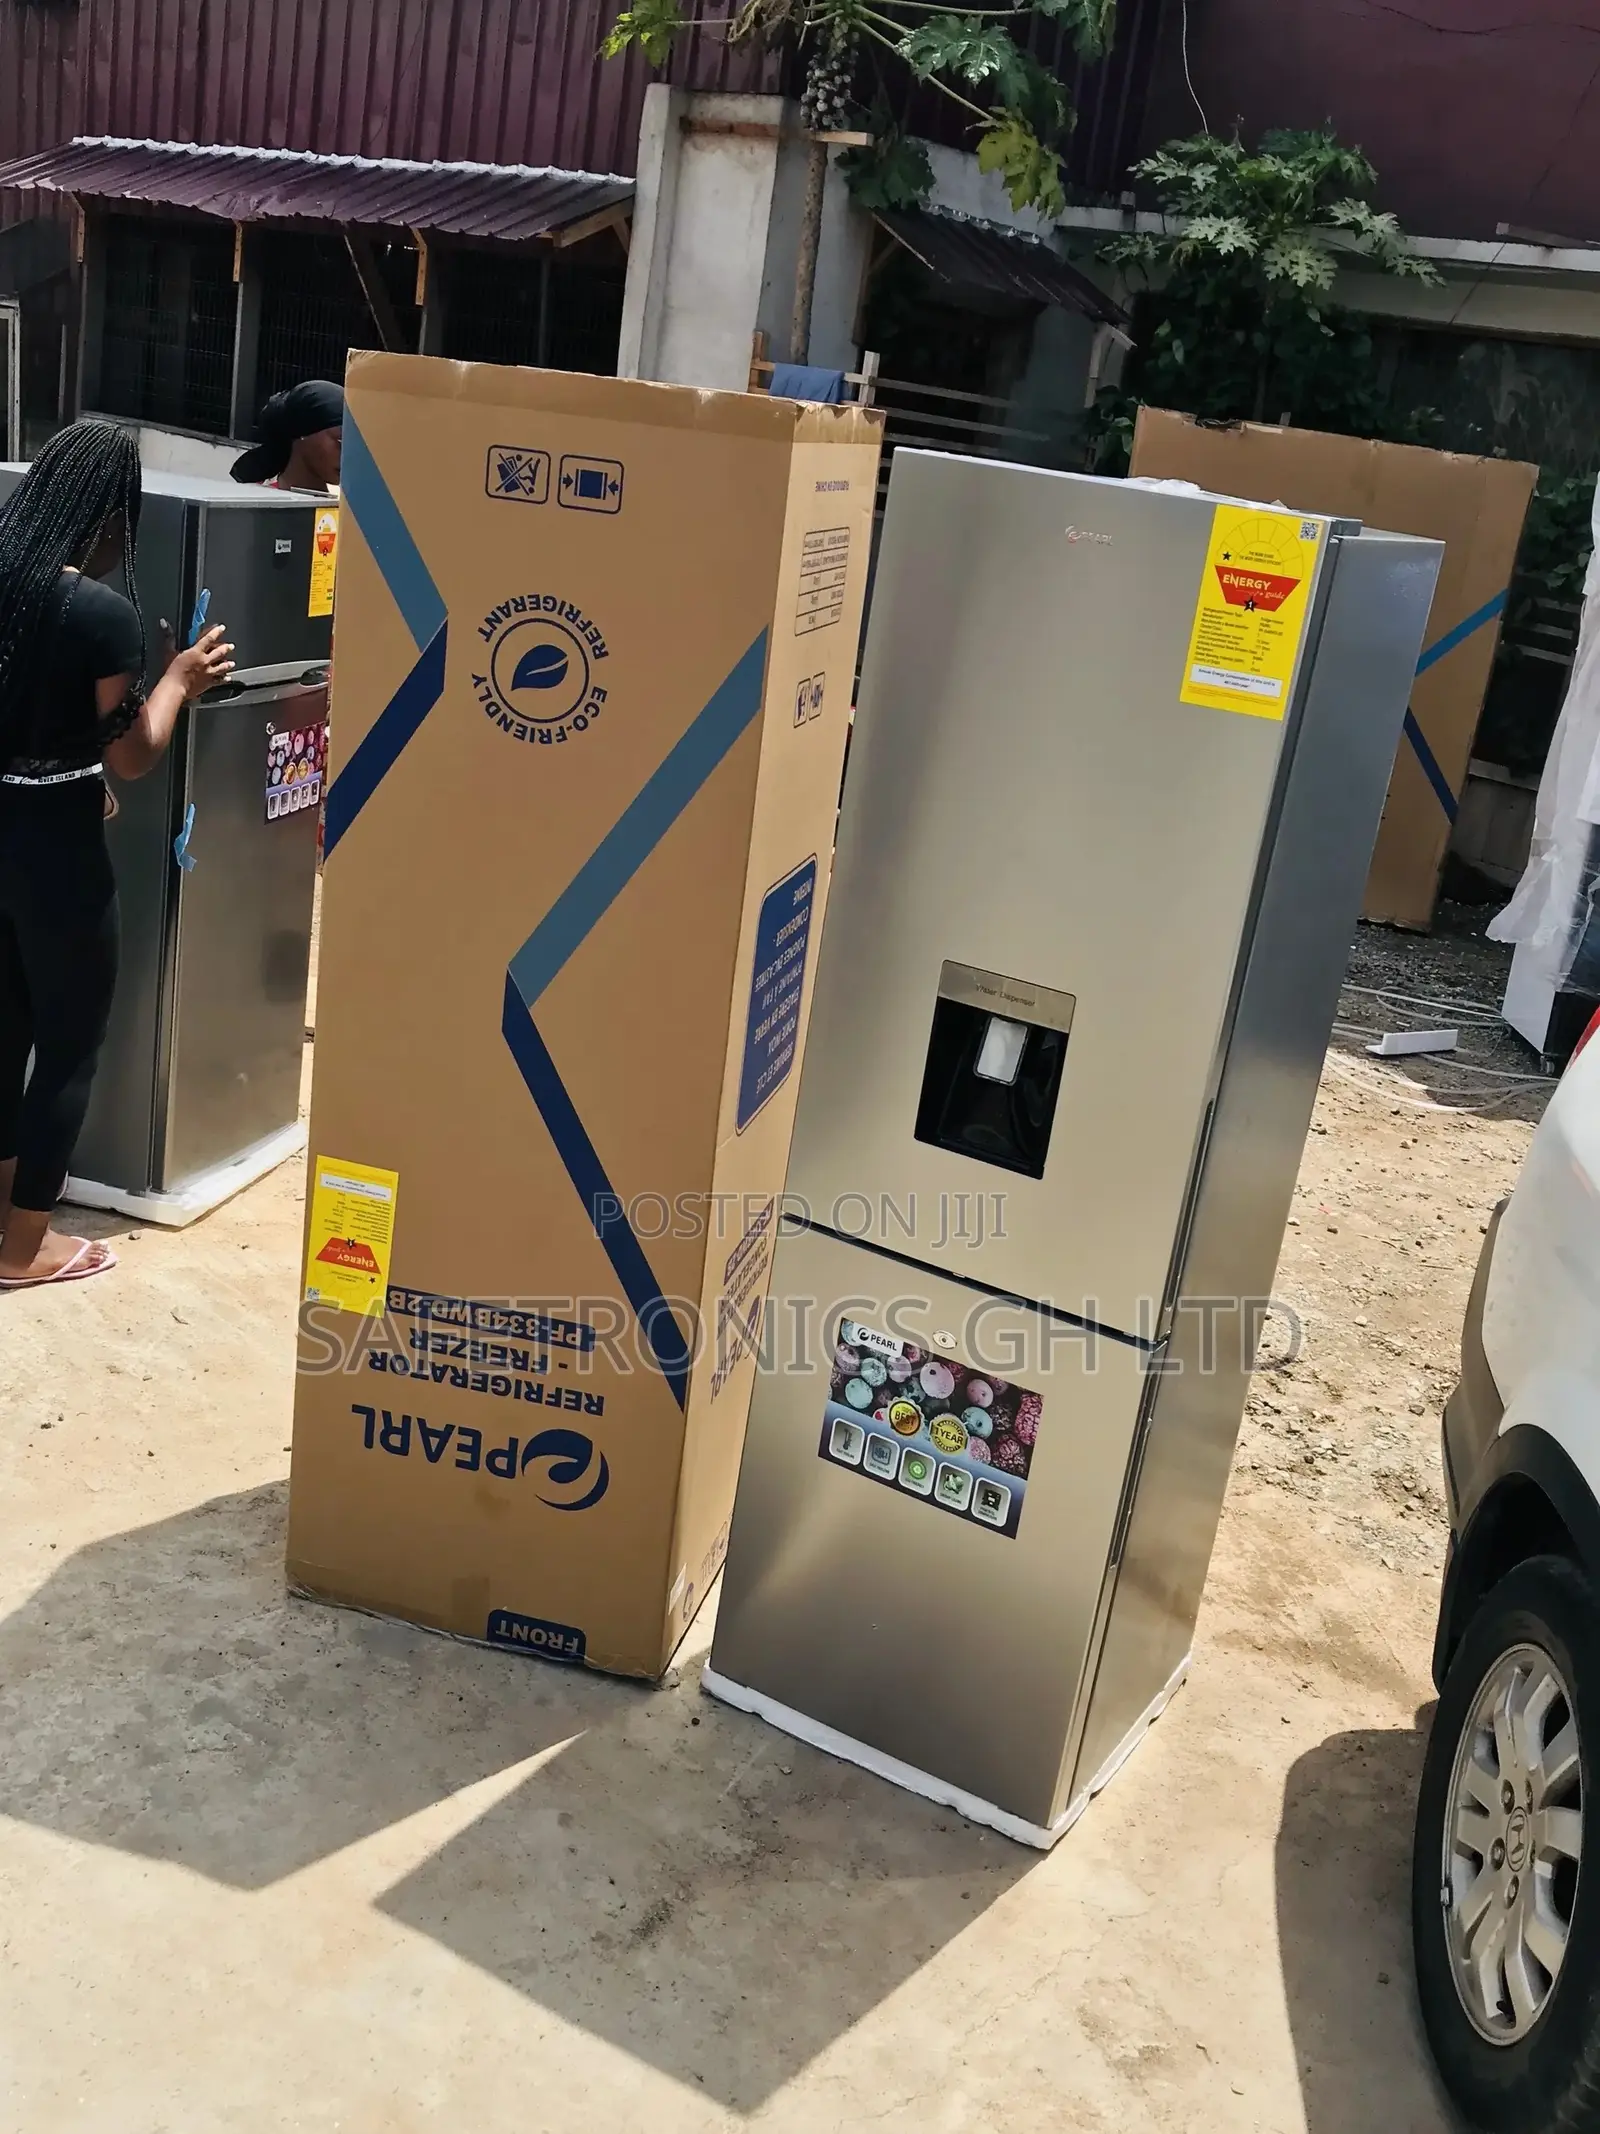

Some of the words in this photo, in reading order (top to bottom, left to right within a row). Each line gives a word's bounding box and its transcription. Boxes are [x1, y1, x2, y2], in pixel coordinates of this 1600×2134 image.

[1222, 572, 1271, 592] ENERGY
[477, 594, 609, 660] REFRIGERANT
[471, 672, 608, 744] ECO-FRIENDLY
[337, 1253, 374, 1268] ENERGY
[389, 1290, 582, 1345] PF-334BWD-2B
[409, 1327, 548, 1375] FREEZER
[869, 1333, 898, 1352] PEARL
[368, 1349, 604, 1416] REFRIGERATOR
[894, 1411, 916, 1426] BEST
[940, 1428, 964, 1445] YEAR
[352, 1404, 519, 1479] PEARL
[495, 1620, 579, 1653] FRONT
